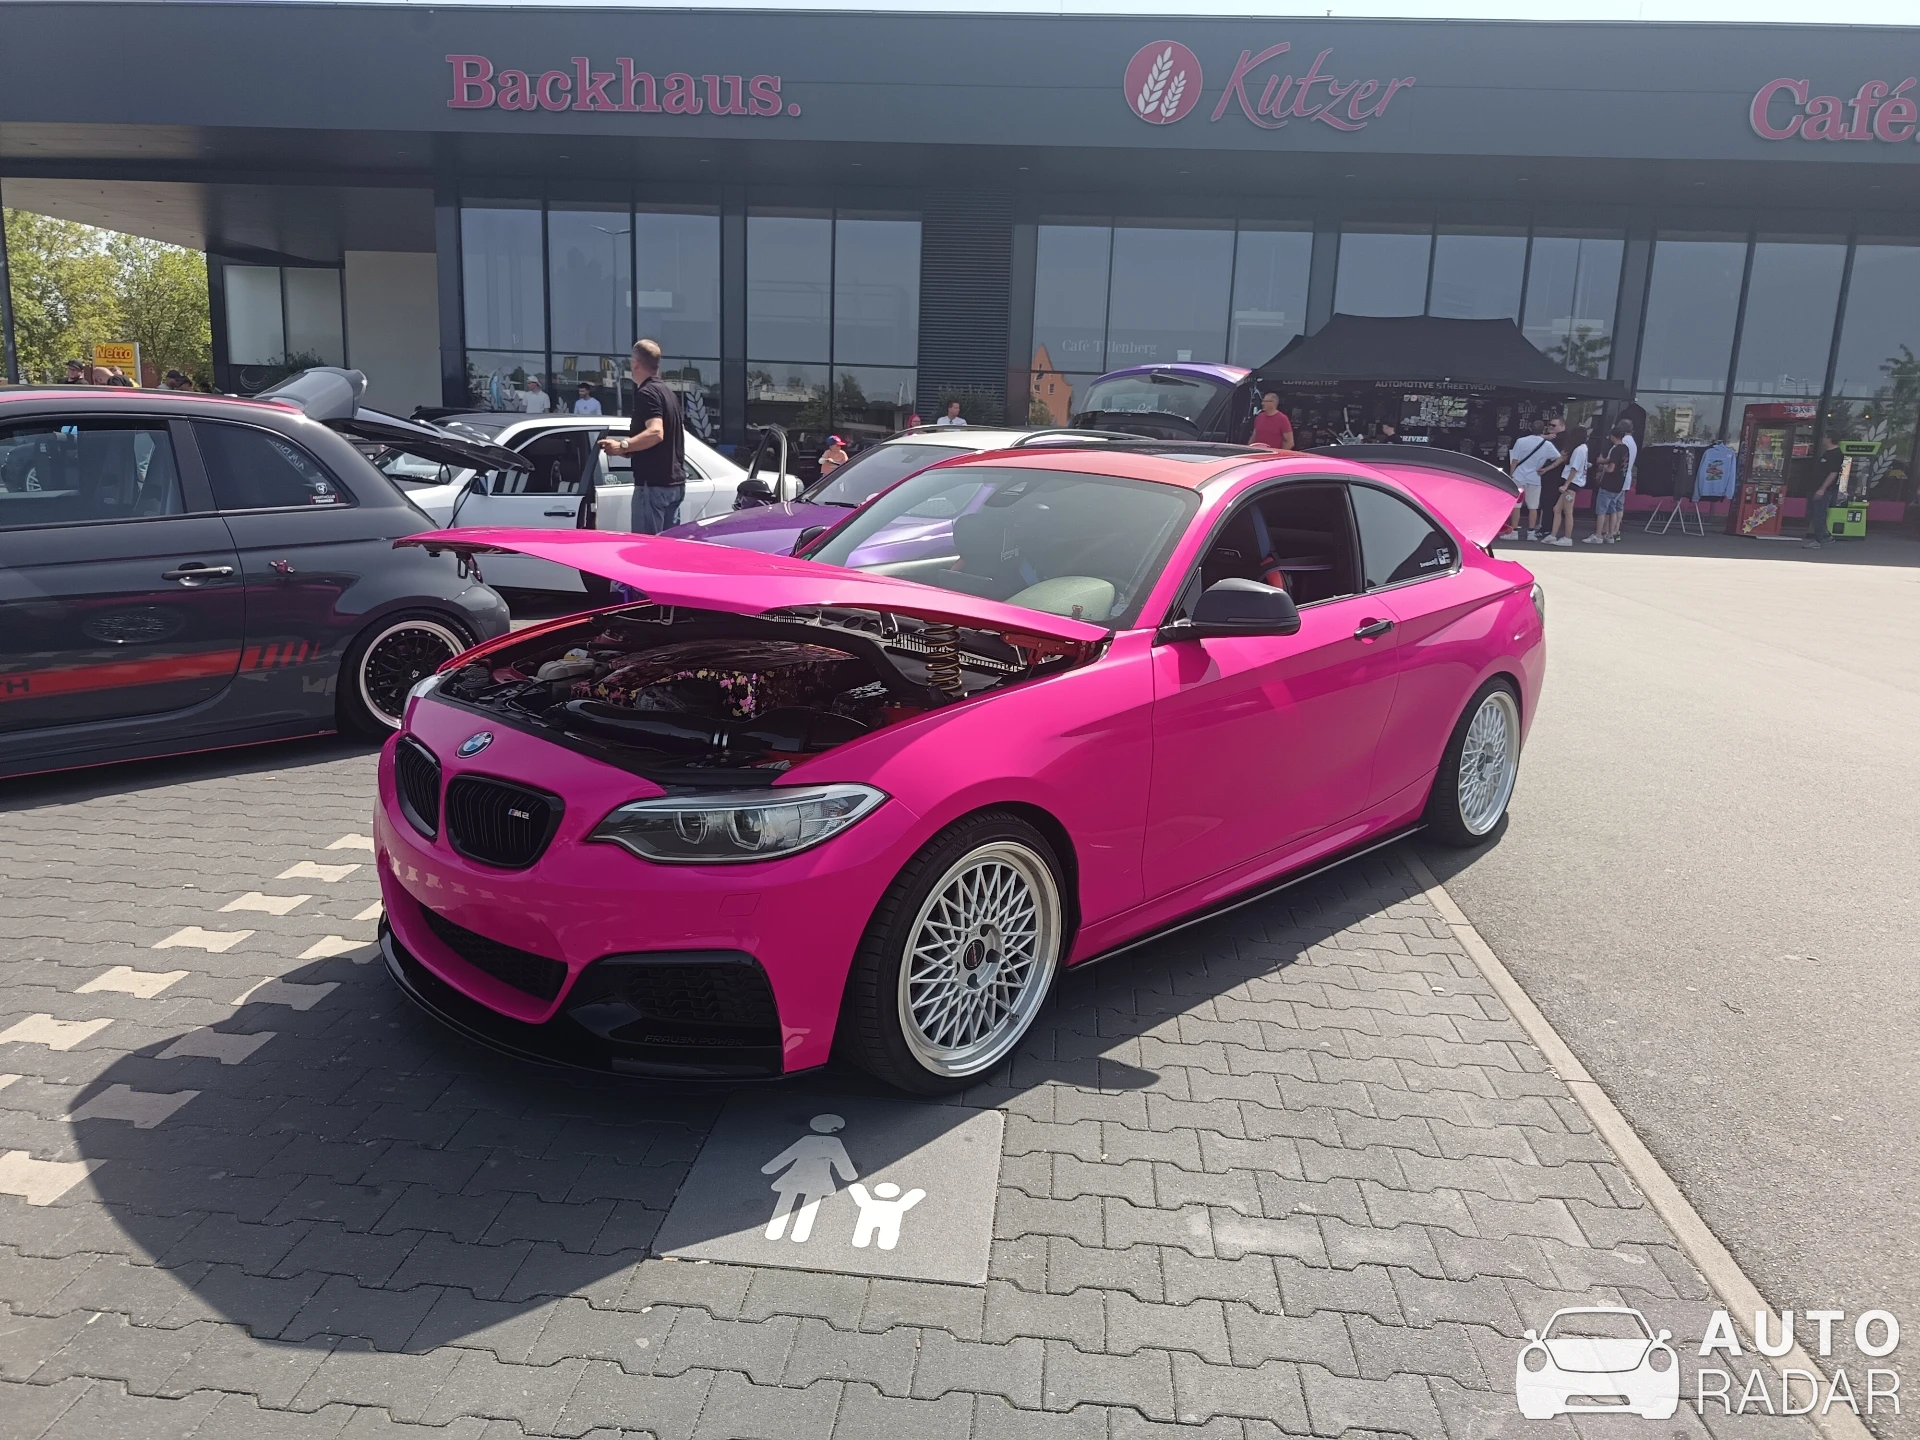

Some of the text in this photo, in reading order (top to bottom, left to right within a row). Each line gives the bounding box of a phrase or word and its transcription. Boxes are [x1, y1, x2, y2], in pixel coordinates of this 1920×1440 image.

[445, 54, 801, 117] Backhaus.
[1210, 41, 1416, 132] Kutzer
[96, 345, 132, 359] Netto
[1062, 340, 1157, 357] Café Tllenberg
[1374, 381, 1497, 391] AUTOMOTIVE STREETWEAR
